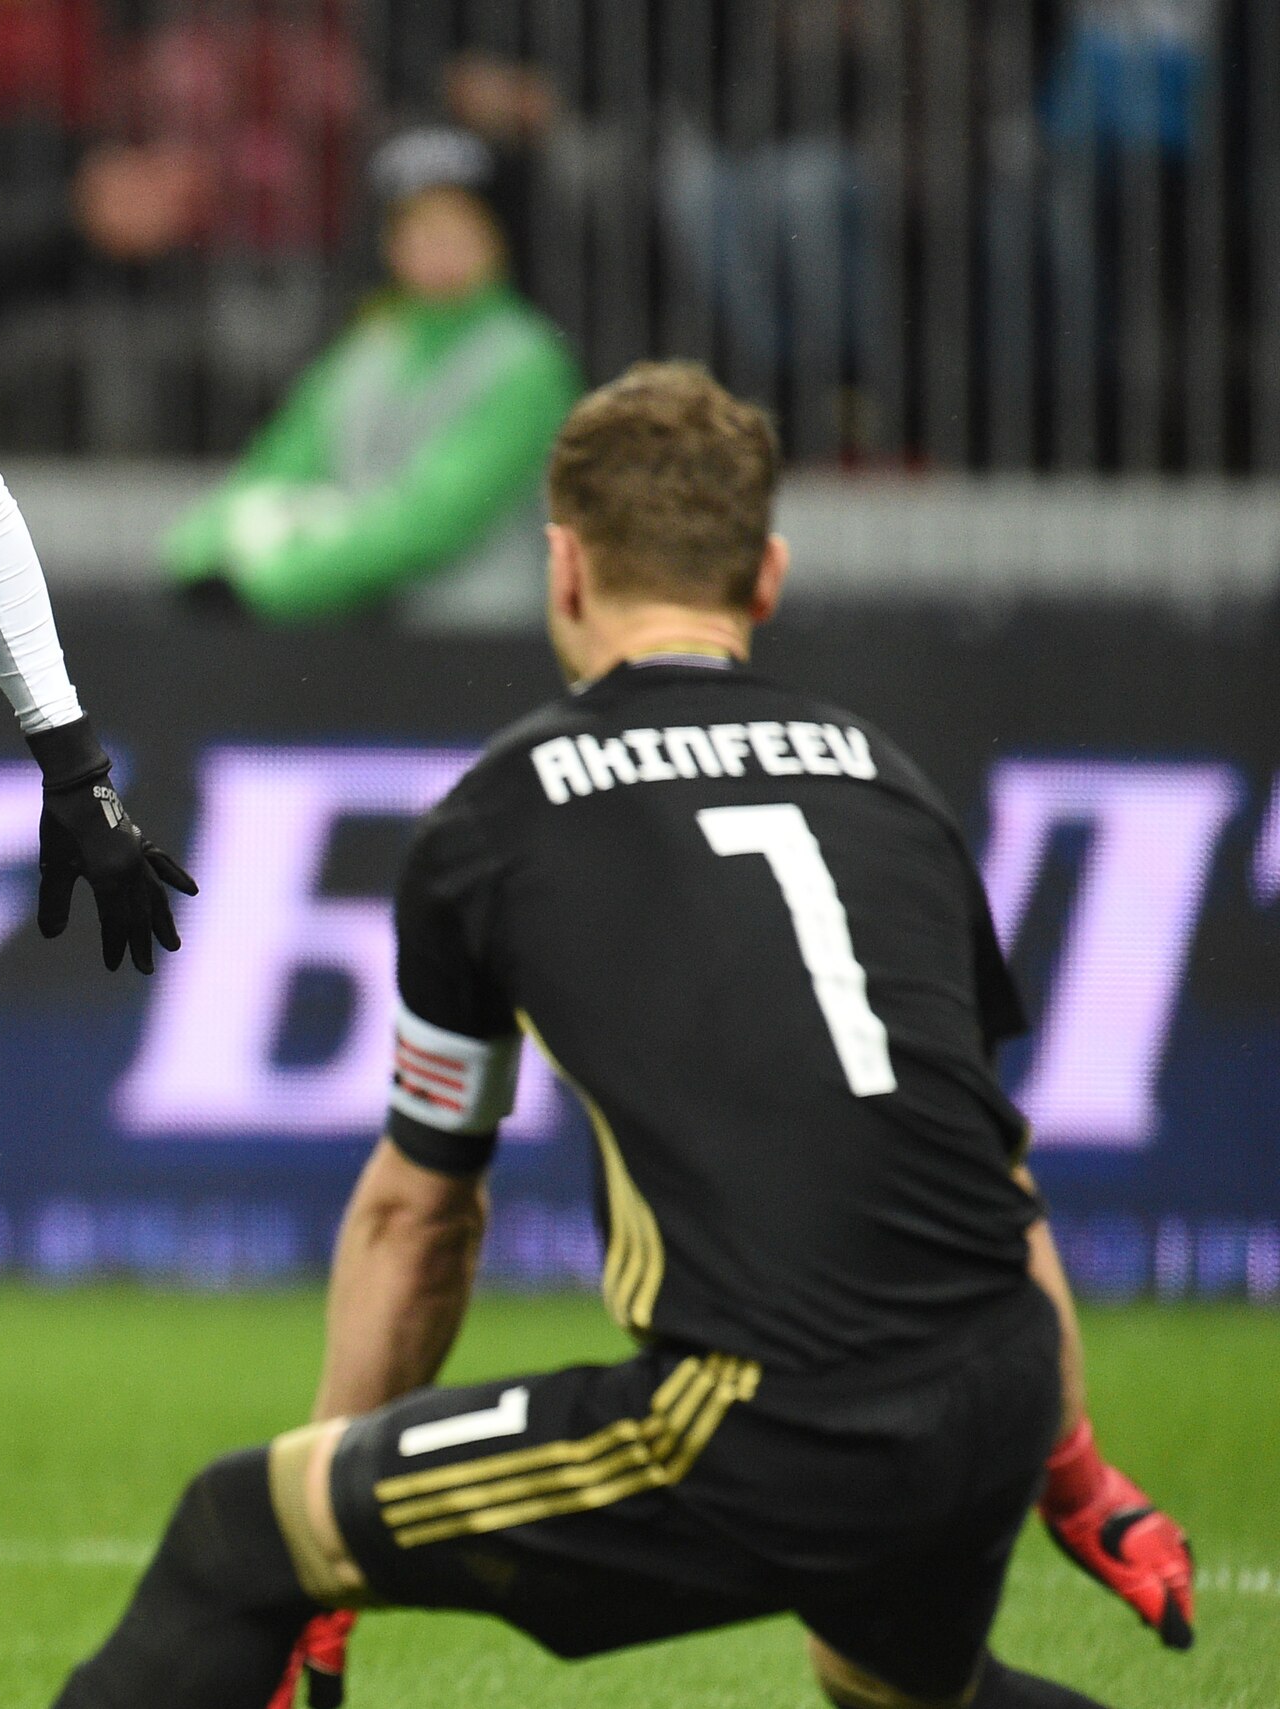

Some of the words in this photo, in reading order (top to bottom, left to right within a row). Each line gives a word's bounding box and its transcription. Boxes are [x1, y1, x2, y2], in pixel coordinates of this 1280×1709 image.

[531, 720, 877, 805] AKINFEEV
[696, 803, 898, 1097] 1
[400, 1385, 531, 1457] 1
